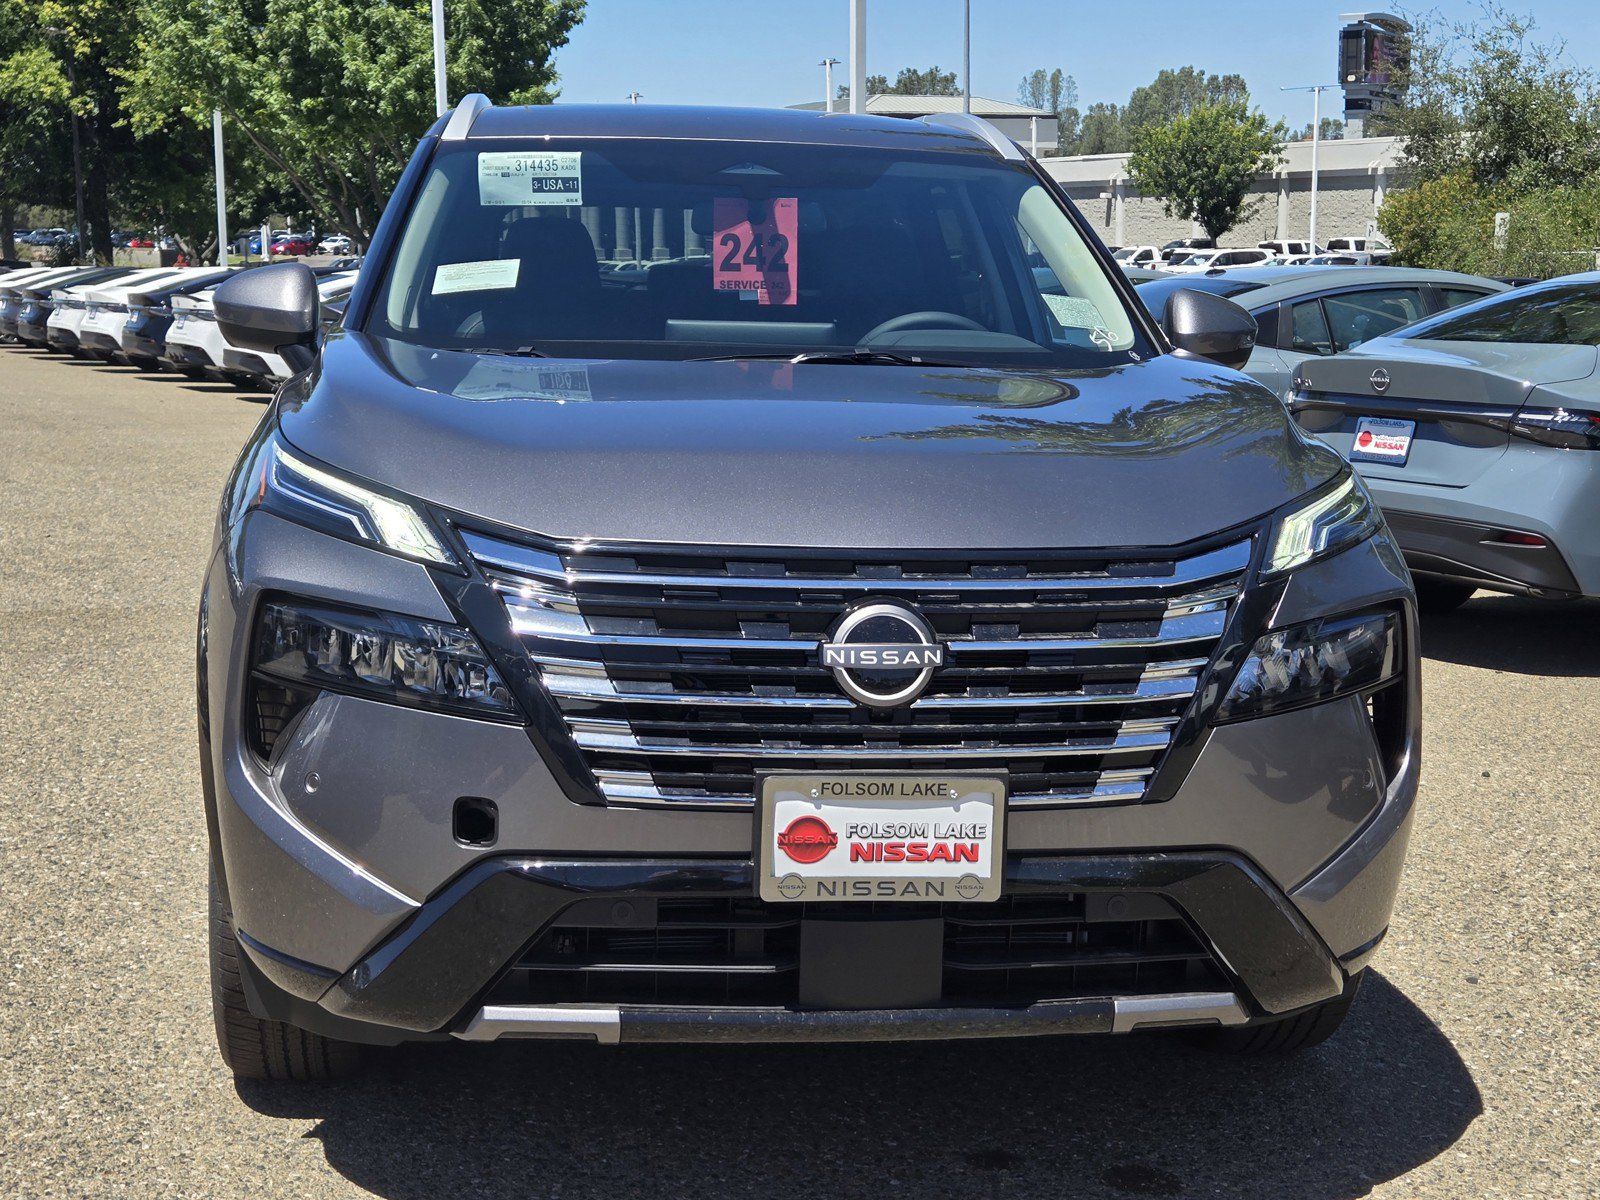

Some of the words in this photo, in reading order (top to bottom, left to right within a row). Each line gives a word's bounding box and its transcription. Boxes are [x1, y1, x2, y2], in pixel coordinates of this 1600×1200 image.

[515, 159, 559, 172] 314435
[543, 179, 564, 190] USA
[719, 233, 789, 272] 242
[720, 280, 767, 290] SERVICE
[1374, 441, 1405, 451] NISSAN
[826, 649, 941, 665] NISSAN
[820, 782, 895, 796] FOLSOM
[900, 783, 948, 797] LAKE
[845, 822, 929, 839] FOLSOM
[934, 823, 987, 840] LAKE
[777, 834, 839, 845] NISSAN
[850, 842, 979, 863] NISSAN
[816, 881, 945, 897] NISSAN
